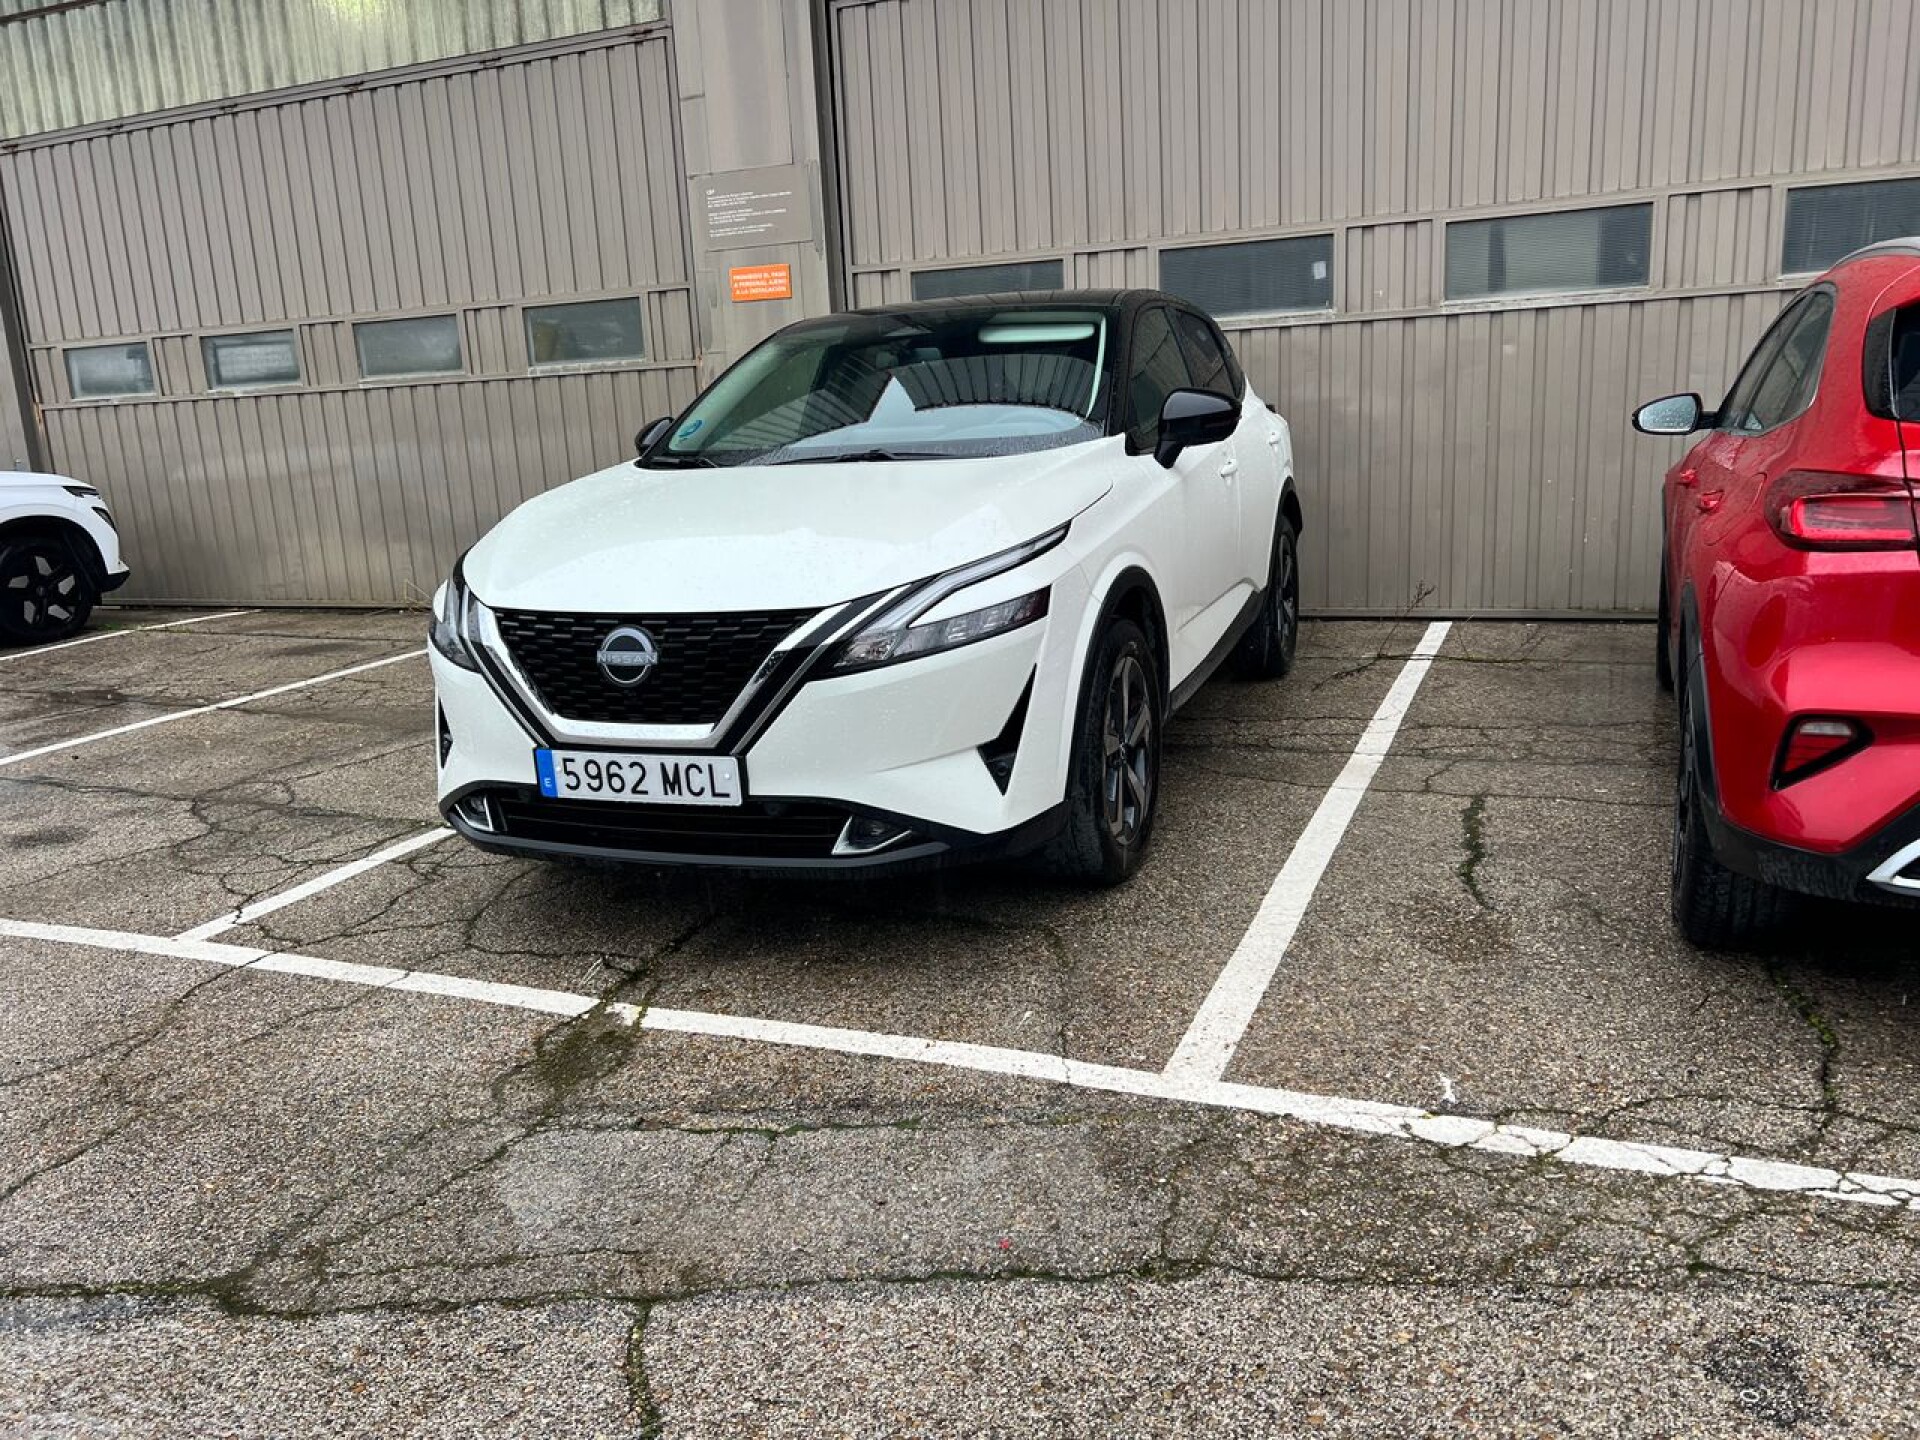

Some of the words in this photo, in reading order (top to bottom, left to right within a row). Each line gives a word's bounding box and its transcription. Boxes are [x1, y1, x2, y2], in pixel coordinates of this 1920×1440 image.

[598, 653, 656, 664] NISSAN
[544, 777, 552, 788] E
[562, 757, 649, 796] 5962
[659, 761, 731, 799] MCL
